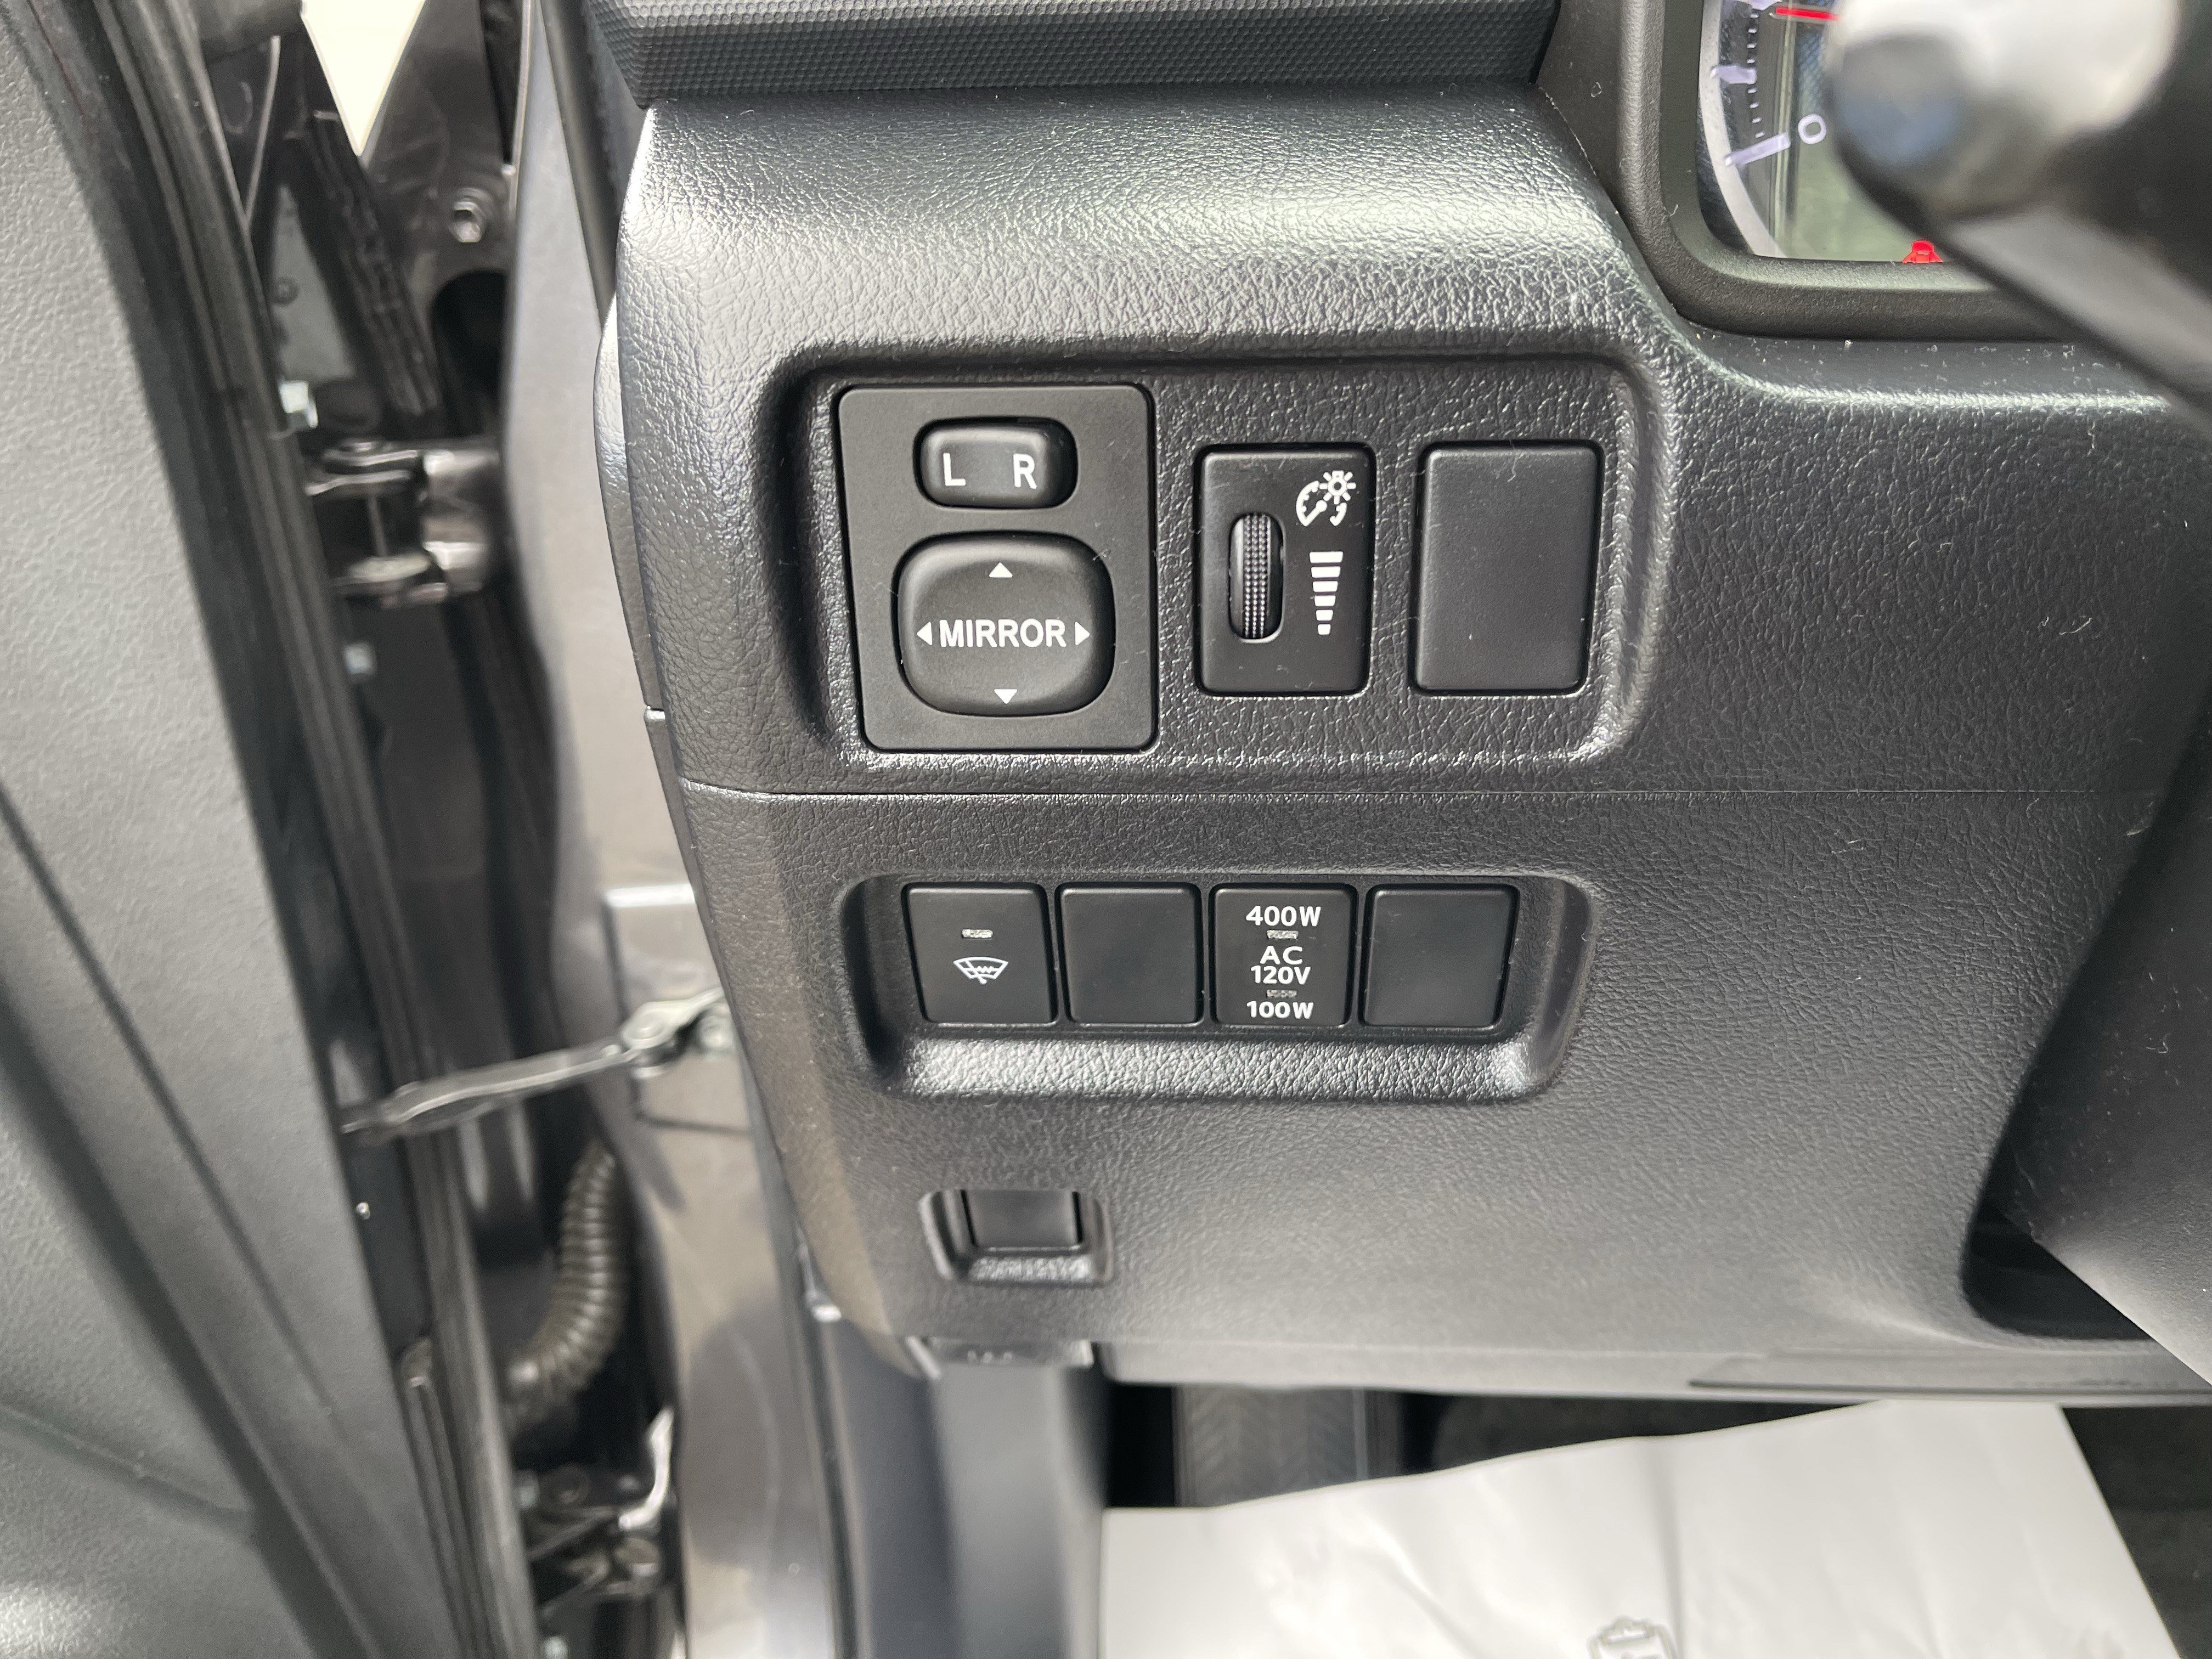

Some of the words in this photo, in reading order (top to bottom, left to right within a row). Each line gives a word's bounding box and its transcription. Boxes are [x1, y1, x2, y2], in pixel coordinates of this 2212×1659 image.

[943, 453, 966, 487] L
[1013, 453, 1037, 489] R
[939, 618, 1067, 648] MIRROR
[1245, 905, 1321, 927] 400W
[1260, 945, 1303, 965] AC
[1250, 965, 1311, 985] 120V
[1246, 1001, 1314, 1019] 100W
